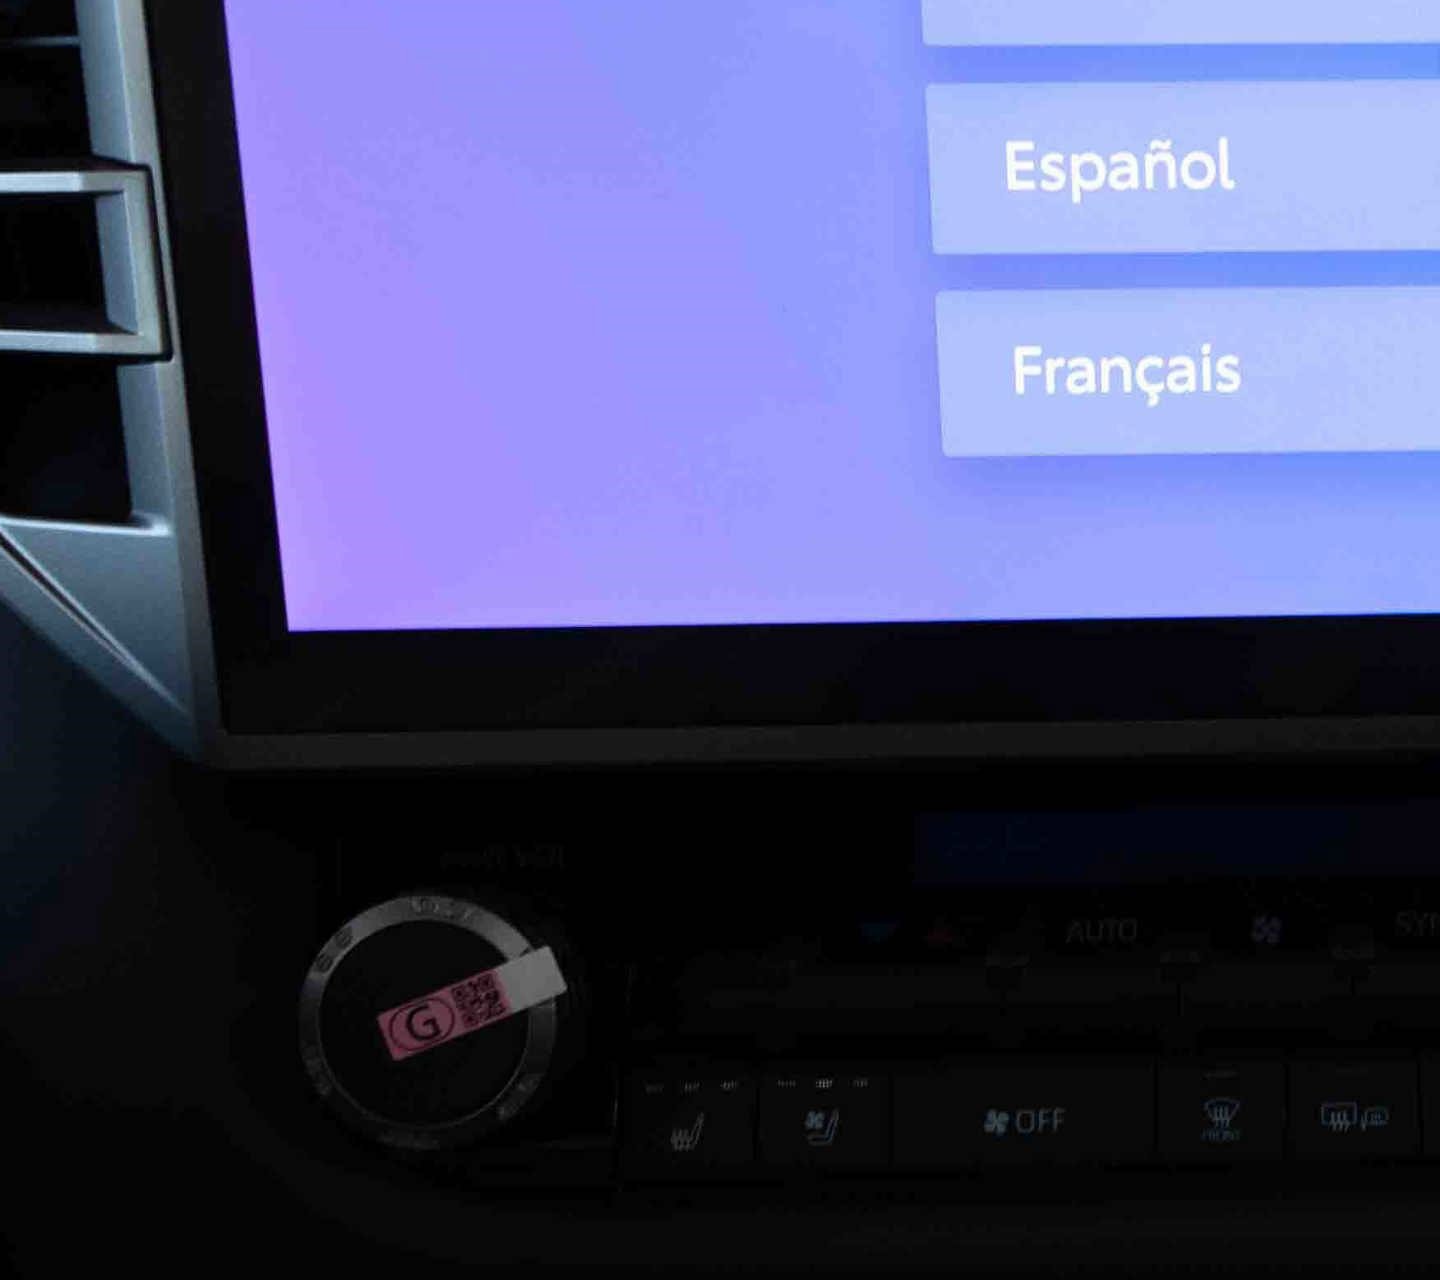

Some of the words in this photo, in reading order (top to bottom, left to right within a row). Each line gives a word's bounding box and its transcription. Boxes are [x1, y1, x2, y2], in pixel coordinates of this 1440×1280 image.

[1005, 137, 1237, 202] Español
[1012, 342, 1241, 407] Français
[1066, 917, 1138, 944] AUTO
[405, 1005, 441, 1042] G
[1014, 1105, 1066, 1134] OFF
